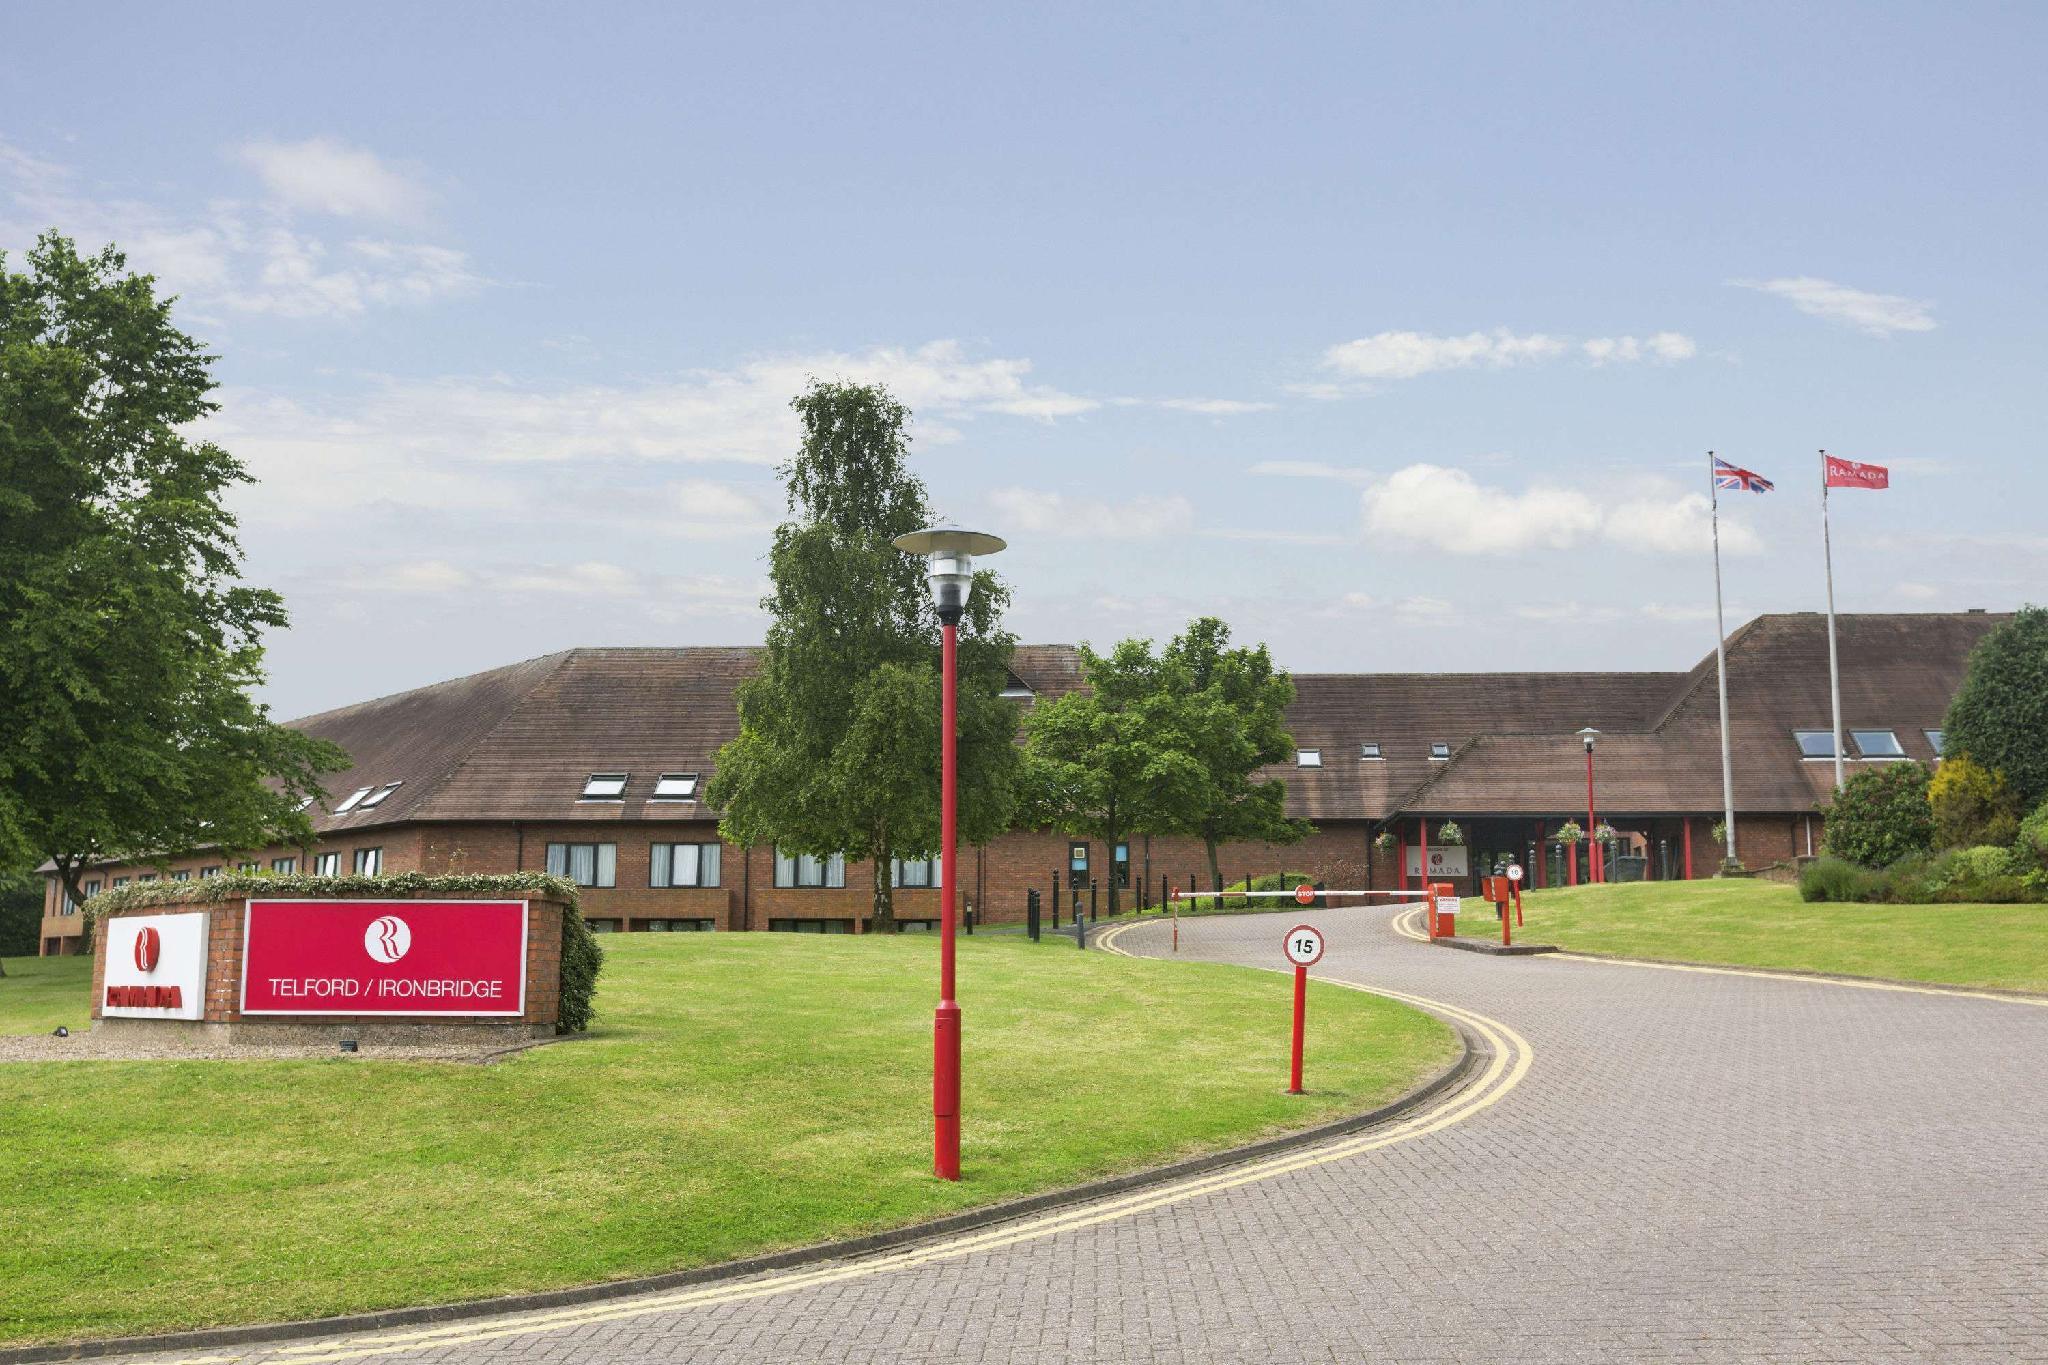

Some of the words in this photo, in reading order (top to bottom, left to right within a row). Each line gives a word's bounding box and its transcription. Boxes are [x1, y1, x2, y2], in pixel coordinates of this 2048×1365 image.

[1296, 939, 1313, 953] 15
[269, 979, 358, 996] TELFORD
[378, 979, 503, 998] IRONBRIDGE
